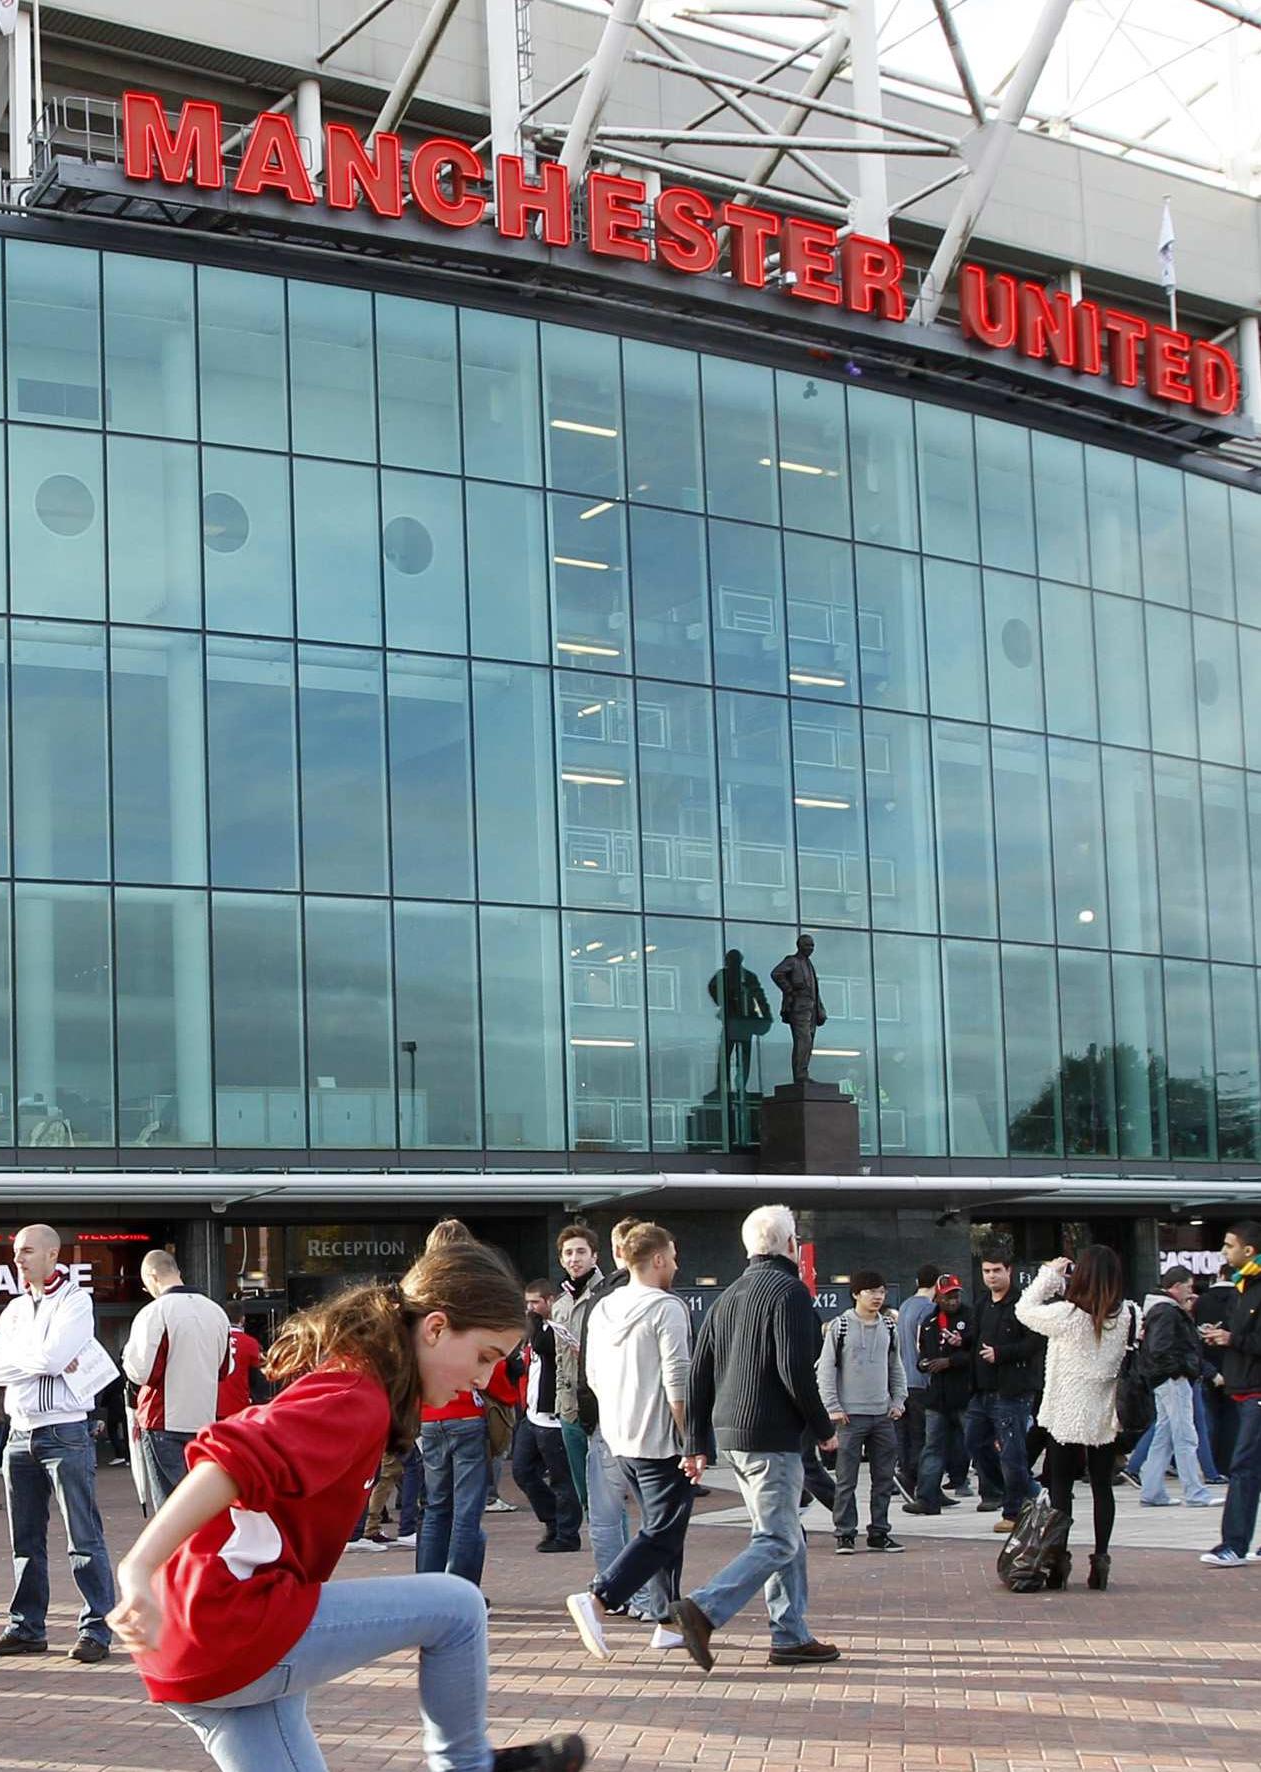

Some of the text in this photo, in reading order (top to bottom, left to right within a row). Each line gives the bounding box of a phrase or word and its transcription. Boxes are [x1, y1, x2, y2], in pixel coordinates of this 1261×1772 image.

[122, 90, 1239, 416] MANCHESTER UNITED
[307, 1239, 405, 1257] RECEPTION
